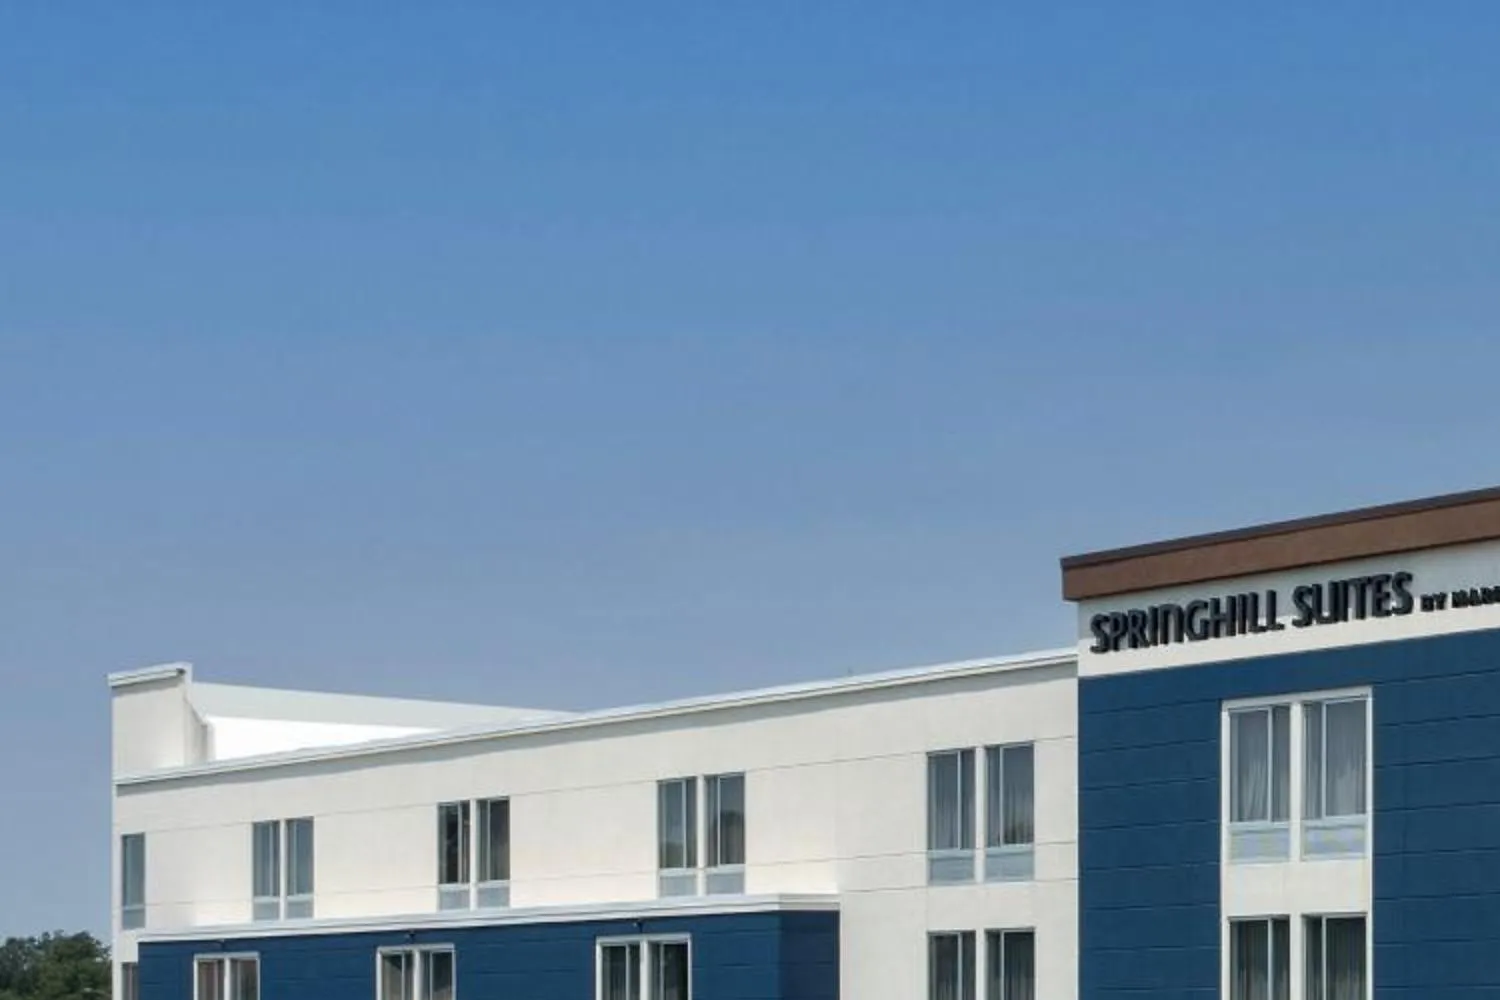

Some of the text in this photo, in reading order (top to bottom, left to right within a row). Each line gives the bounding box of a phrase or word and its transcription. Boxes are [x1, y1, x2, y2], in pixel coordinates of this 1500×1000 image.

[1089, 589, 1285, 654] SPRINGHILL
[1292, 571, 1414, 628] SUITES
[1420, 592, 1447, 612] BY
